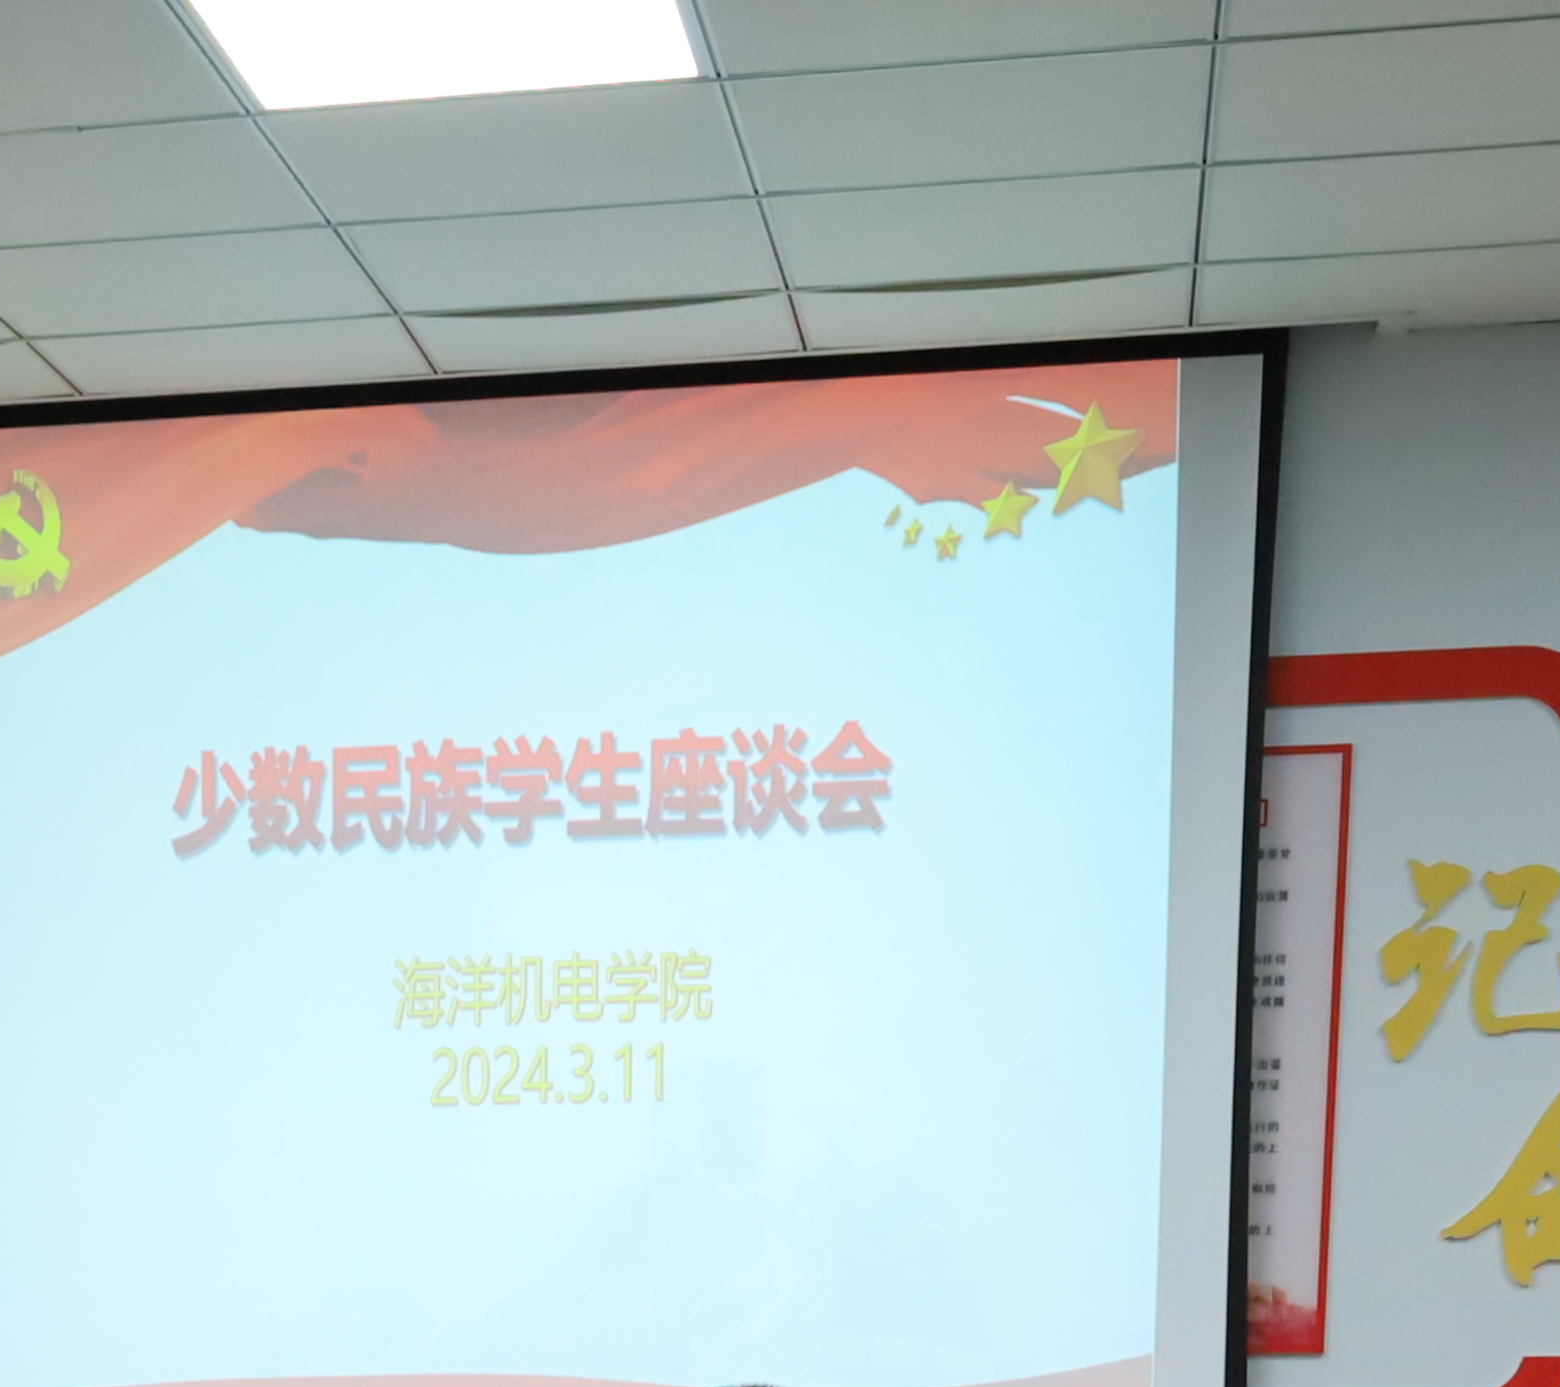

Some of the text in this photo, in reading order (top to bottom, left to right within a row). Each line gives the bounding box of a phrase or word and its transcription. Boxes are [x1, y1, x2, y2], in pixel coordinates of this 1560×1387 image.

[170, 720, 893, 858] 少数民族学生座谈会
[392, 950, 713, 1030] 海洋机电学院
[430, 1043, 666, 1106] 2024.3.11
